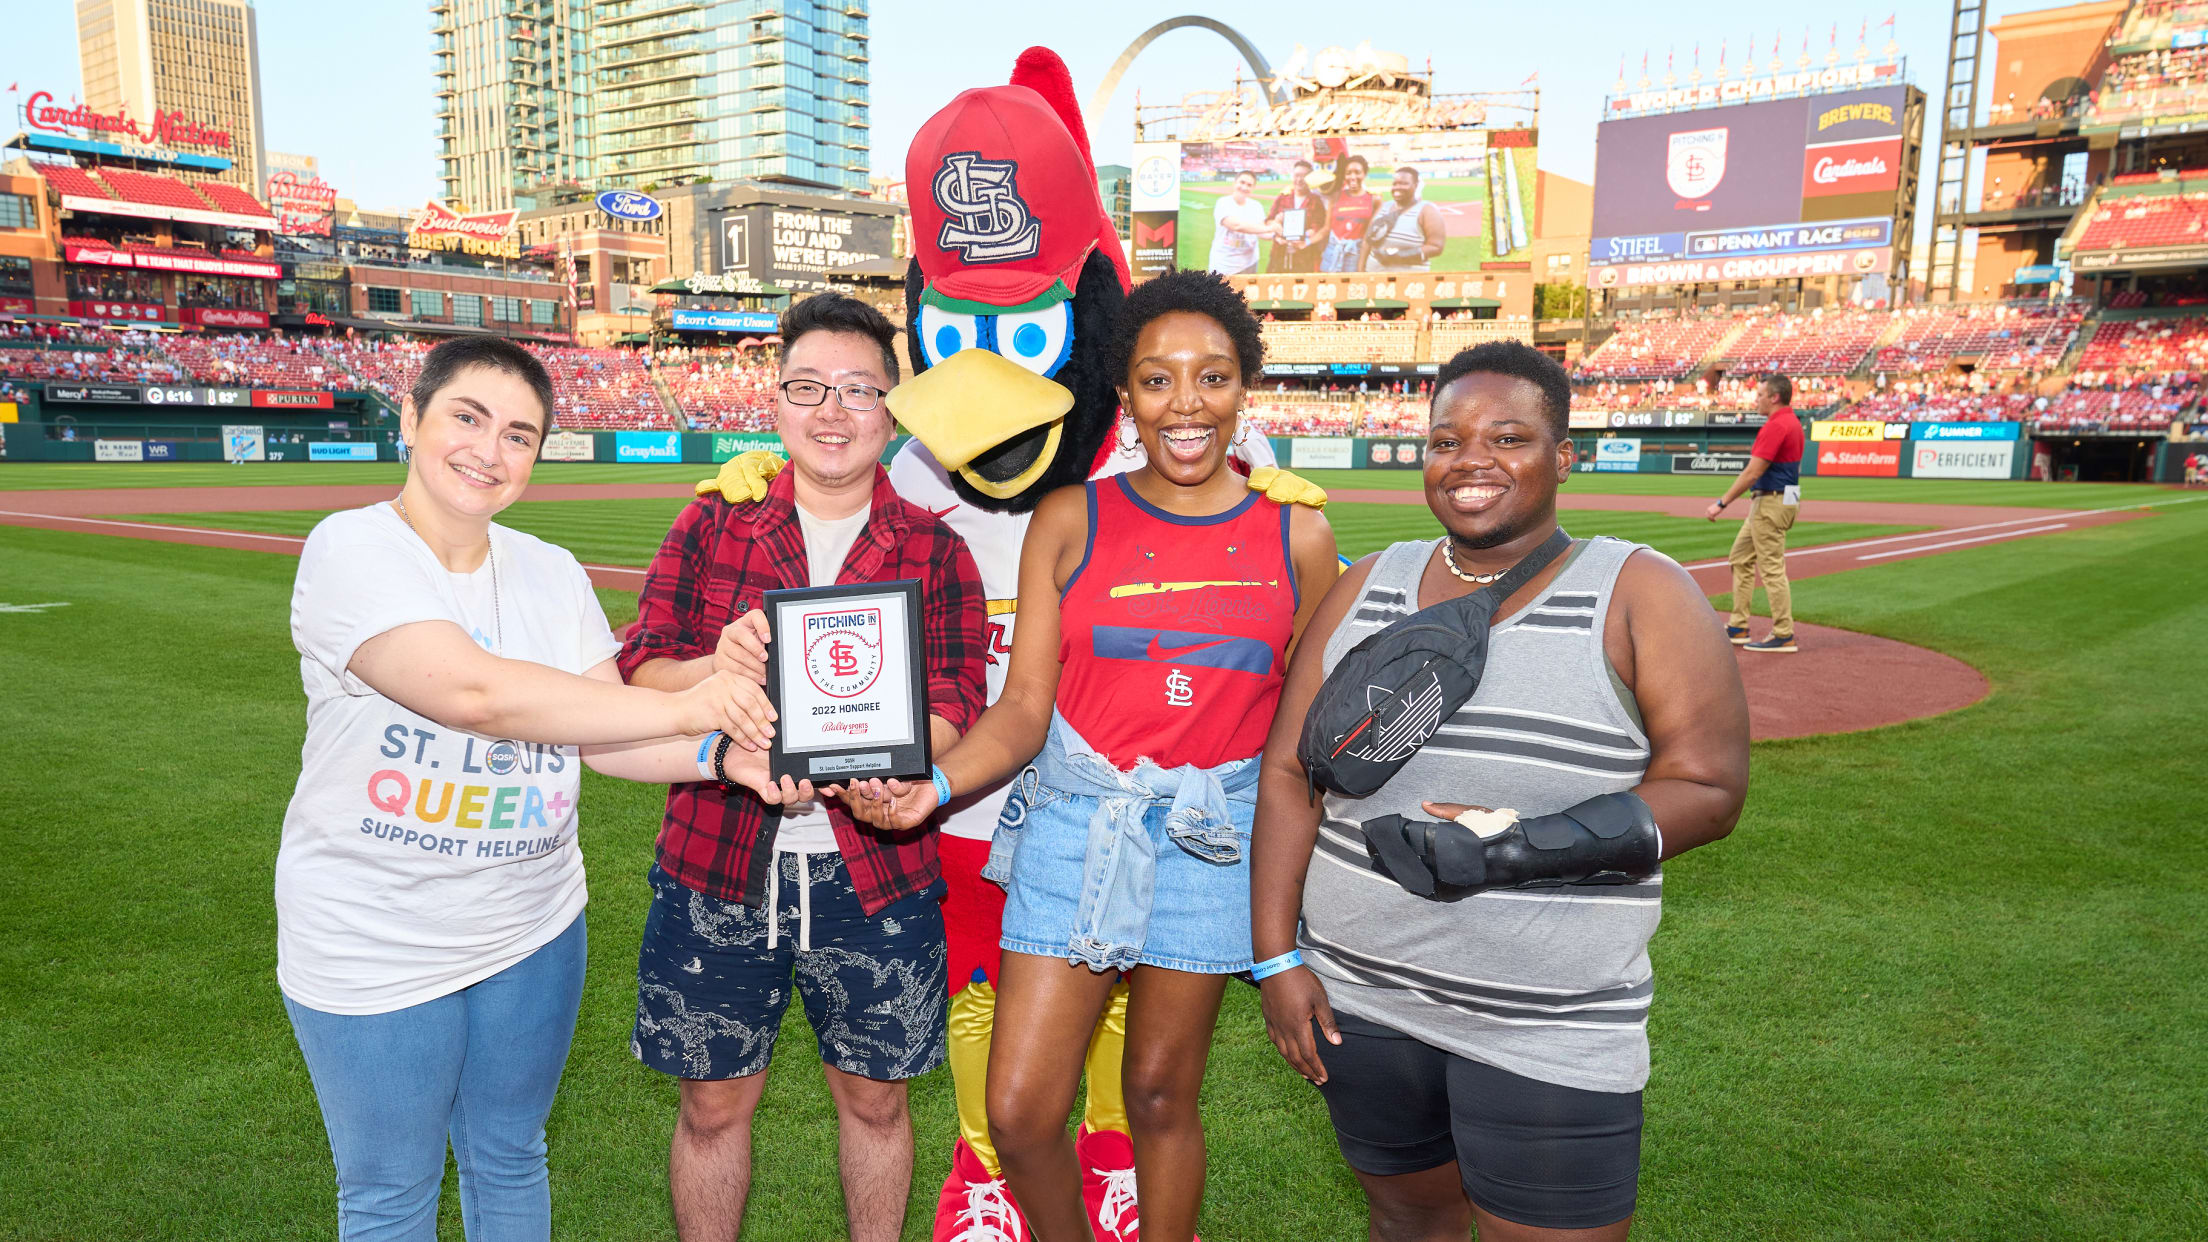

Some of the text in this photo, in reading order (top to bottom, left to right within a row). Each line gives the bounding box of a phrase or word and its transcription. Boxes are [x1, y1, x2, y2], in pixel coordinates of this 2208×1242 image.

[1630, 65, 1876, 110] WORLD CHAMPIONS
[26, 91, 232, 148] Cardinals Nation
[1818, 102, 1893, 131] BREWERS
[1813, 156, 1887, 184] Cardinals
[613, 193, 650, 216] Ford
[412, 208, 517, 236] Budweiser
[773, 211, 853, 235] FROM THE
[409, 232, 521, 260] BREW HOUSE
[773, 228, 843, 250] LOU AND
[1609, 236, 1663, 257] STIFEL
[1718, 231, 1794, 250] PENNANT
[1797, 228, 1843, 245] RACE
[149, 256, 172, 268] TEAM
[173, 258, 193, 270] THAT
[194, 260, 223, 273] ENJOYS
[773, 246, 826, 266] WE'RE
[1627, 263, 1702, 284] BROWN
[1706, 266, 1719, 278] &
[774, 278, 810, 290] 1ST
[676, 314, 774, 328] SCOTT CREDIT UNION
[57, 389, 81, 400] Mercy
[166, 390, 194, 403] 6:16
[277, 394, 319, 405] PURINA
[1628, 412, 1652, 424] 6:16
[1715, 413, 1737, 424] Mercy
[223, 425, 263, 436] CarShield
[1829, 425, 1876, 437] FABICK
[149, 445, 169, 454] WR
[1917, 449, 2009, 469] PERFICIENT
[1691, 458, 1721, 472] Bally
[1178, 585, 1271, 629] Louis
[808, 614, 877, 630] PITCHING IN
[820, 678, 835, 690] THE
[840, 654, 877, 692] COMMUNITY
[812, 701, 881, 716] 2022 HONOREE
[821, 721, 849, 733] Bally
[848, 722, 869, 730] SPORTS
[380, 723, 440, 768] ST.
[491, 753, 514, 761] SQSH
[367, 769, 571, 829] QUEER+
[360, 817, 560, 857] SUPPORT HELPLINE
